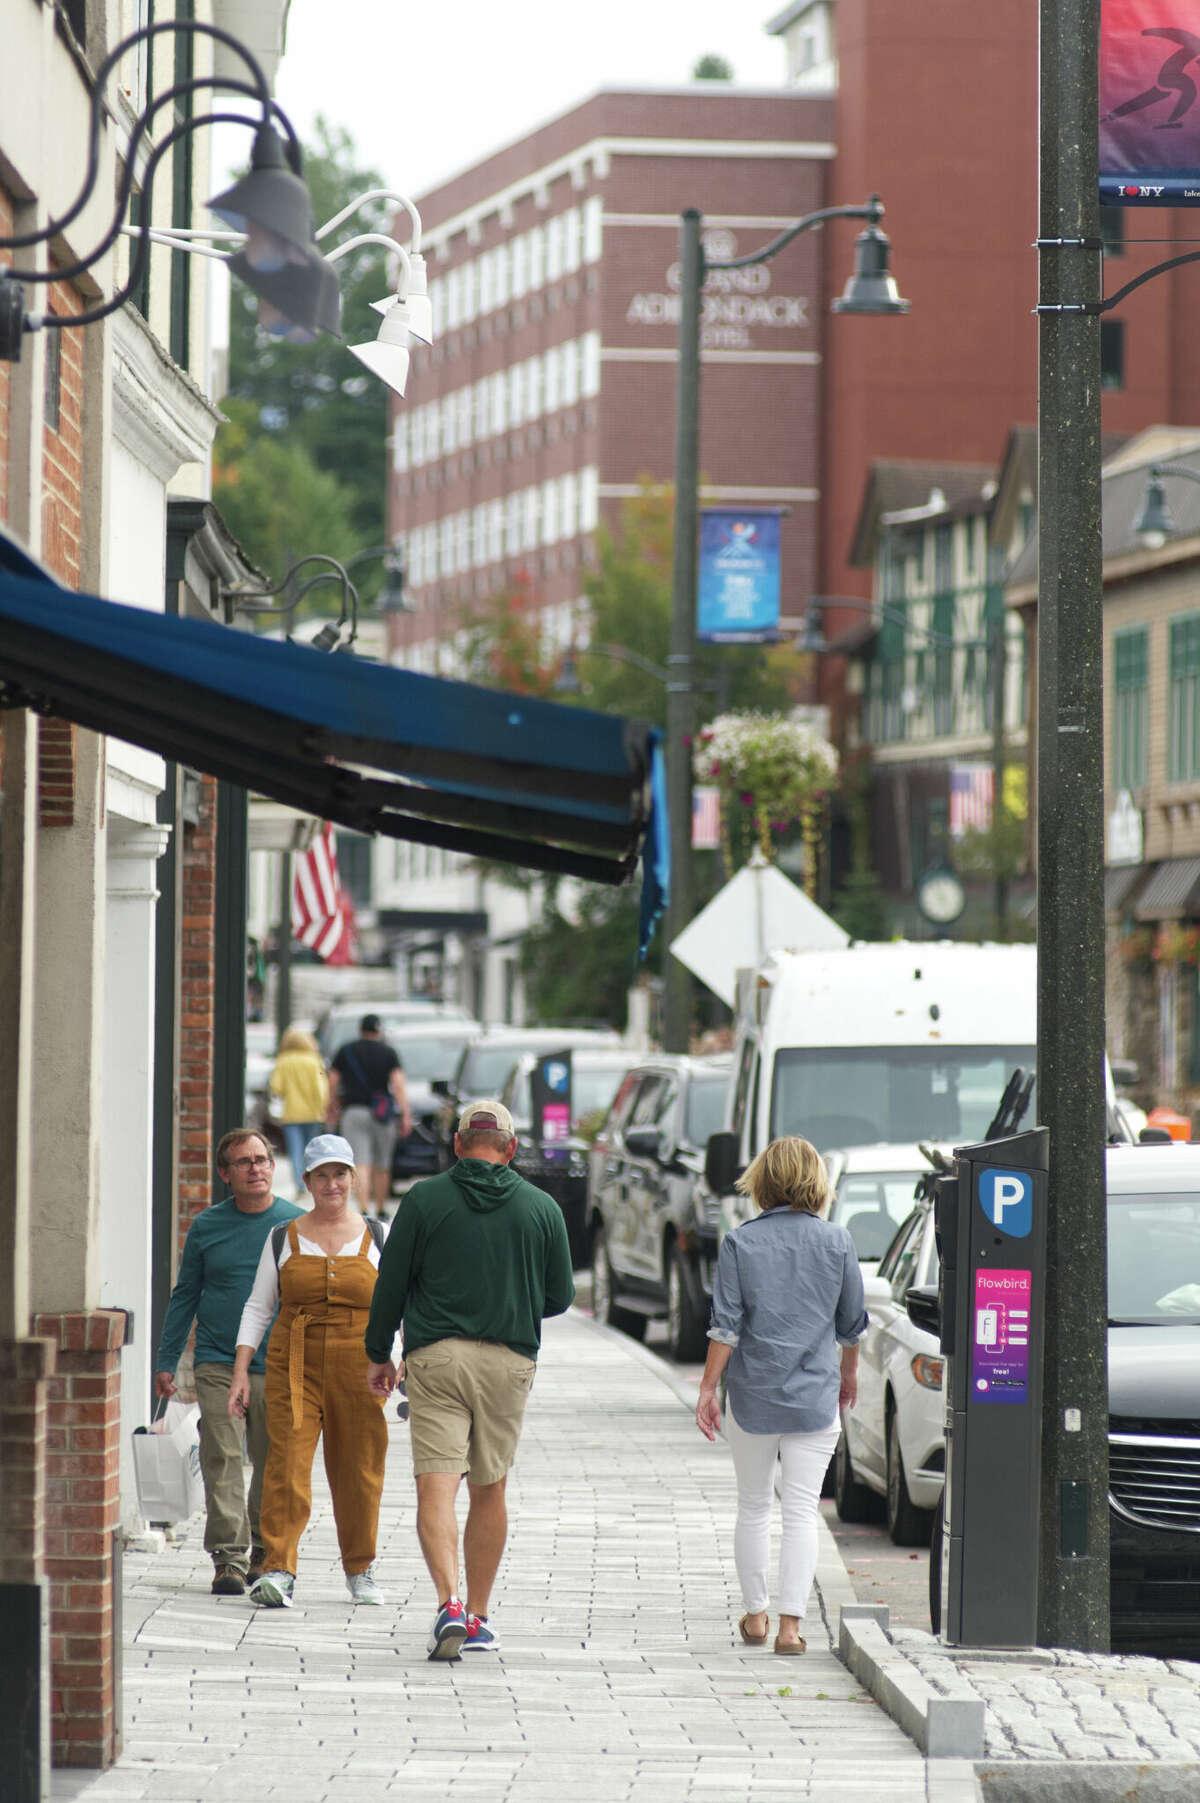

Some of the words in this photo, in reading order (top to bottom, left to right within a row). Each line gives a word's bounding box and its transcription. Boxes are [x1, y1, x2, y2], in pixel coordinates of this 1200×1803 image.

[1118, 185, 1126, 197] I
[1139, 186, 1165, 197] NY
[666, 262, 771, 294] GAND
[547, 1061, 568, 1090] P
[993, 1176, 1025, 1225] P
